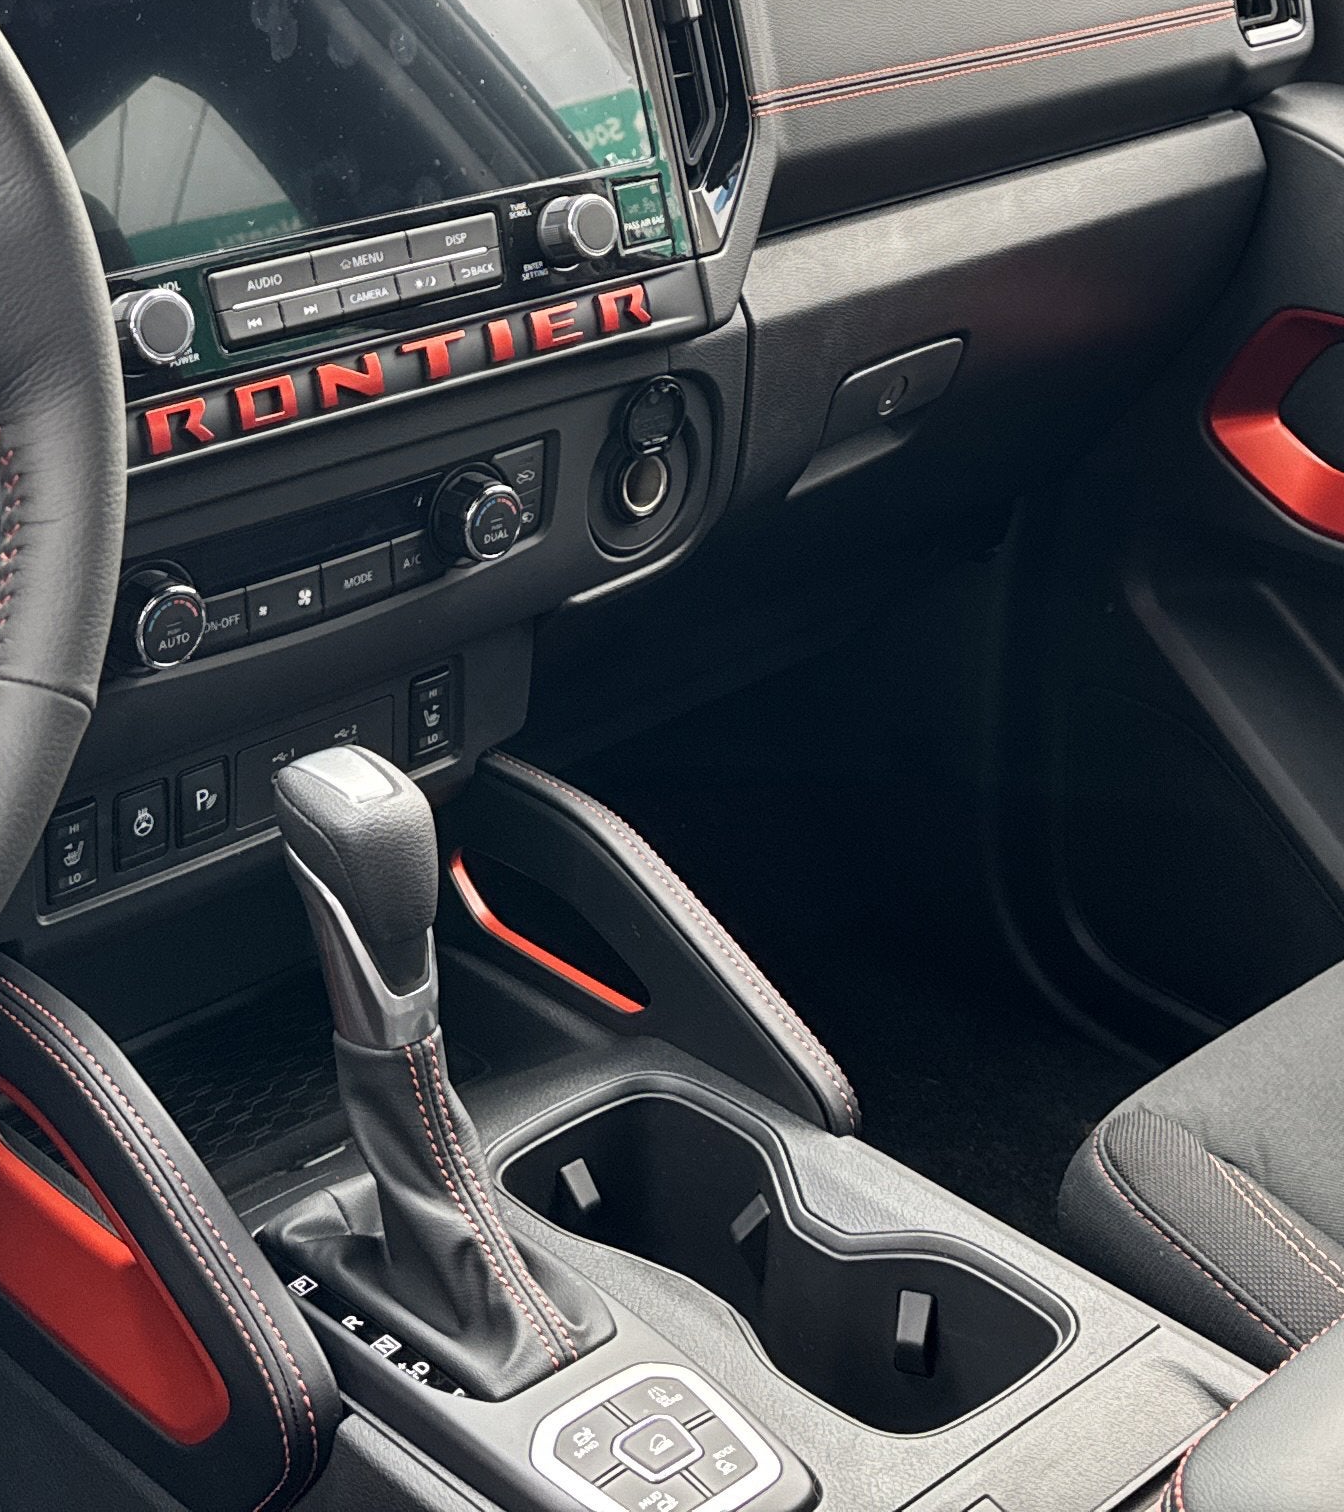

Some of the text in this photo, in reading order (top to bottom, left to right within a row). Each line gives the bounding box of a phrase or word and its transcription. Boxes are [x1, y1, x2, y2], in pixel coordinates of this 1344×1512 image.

[446, 232, 467, 246] DISP
[352, 251, 384, 267] MENU
[470, 262, 494, 277] BACK
[247, 274, 283, 291] AUDIO
[350, 286, 389, 304] CAMERA
[145, 284, 652, 455] RONTIER
[484, 529, 508, 544] DUAL
[403, 554, 421, 568] A/C
[344, 571, 373, 589] MODE
[204, 614, 241, 634] ON-OFF
[159, 633, 190, 651] AUTO
[428, 689, 438, 698] HI
[427, 734, 439, 743] LO
[68, 824, 80, 834] HI
[68, 873, 81, 884] LO
[342, 1316, 364, 1331] R
[412, 1362, 430, 1377] D
[574, 1440, 599, 1459] SAND
[713, 1445, 737, 1459] ROCK
[639, 1490, 662, 1508] MUD
